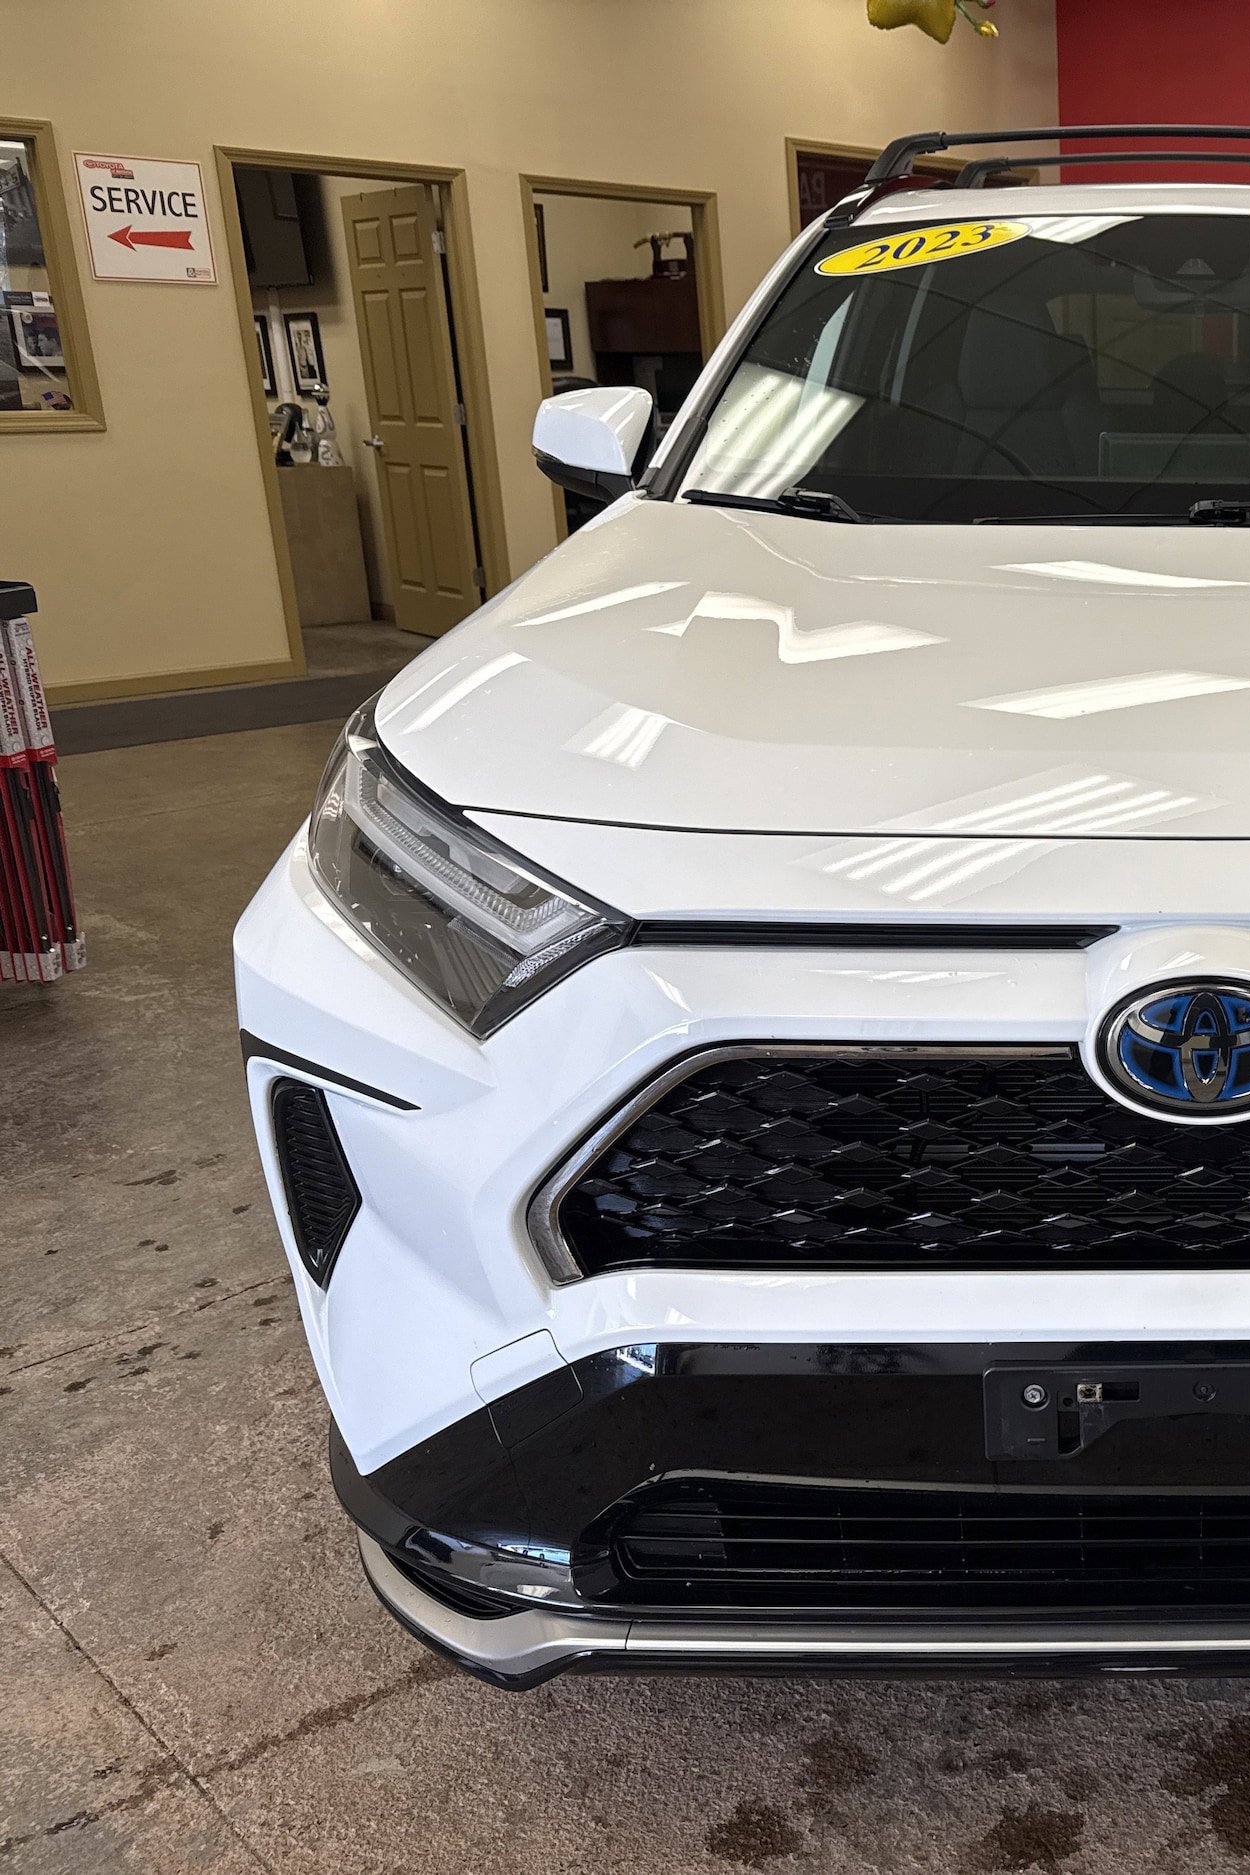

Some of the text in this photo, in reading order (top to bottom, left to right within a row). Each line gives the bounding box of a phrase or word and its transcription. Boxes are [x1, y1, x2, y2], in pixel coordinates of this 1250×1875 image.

[90, 185, 198, 218] SERVICE
[854, 224, 996, 270] 2023
[25, 647, 48, 728] ALL-WEATHER
[28, 685, 37, 708] WIPER
[33, 708, 41, 731] BLADE
